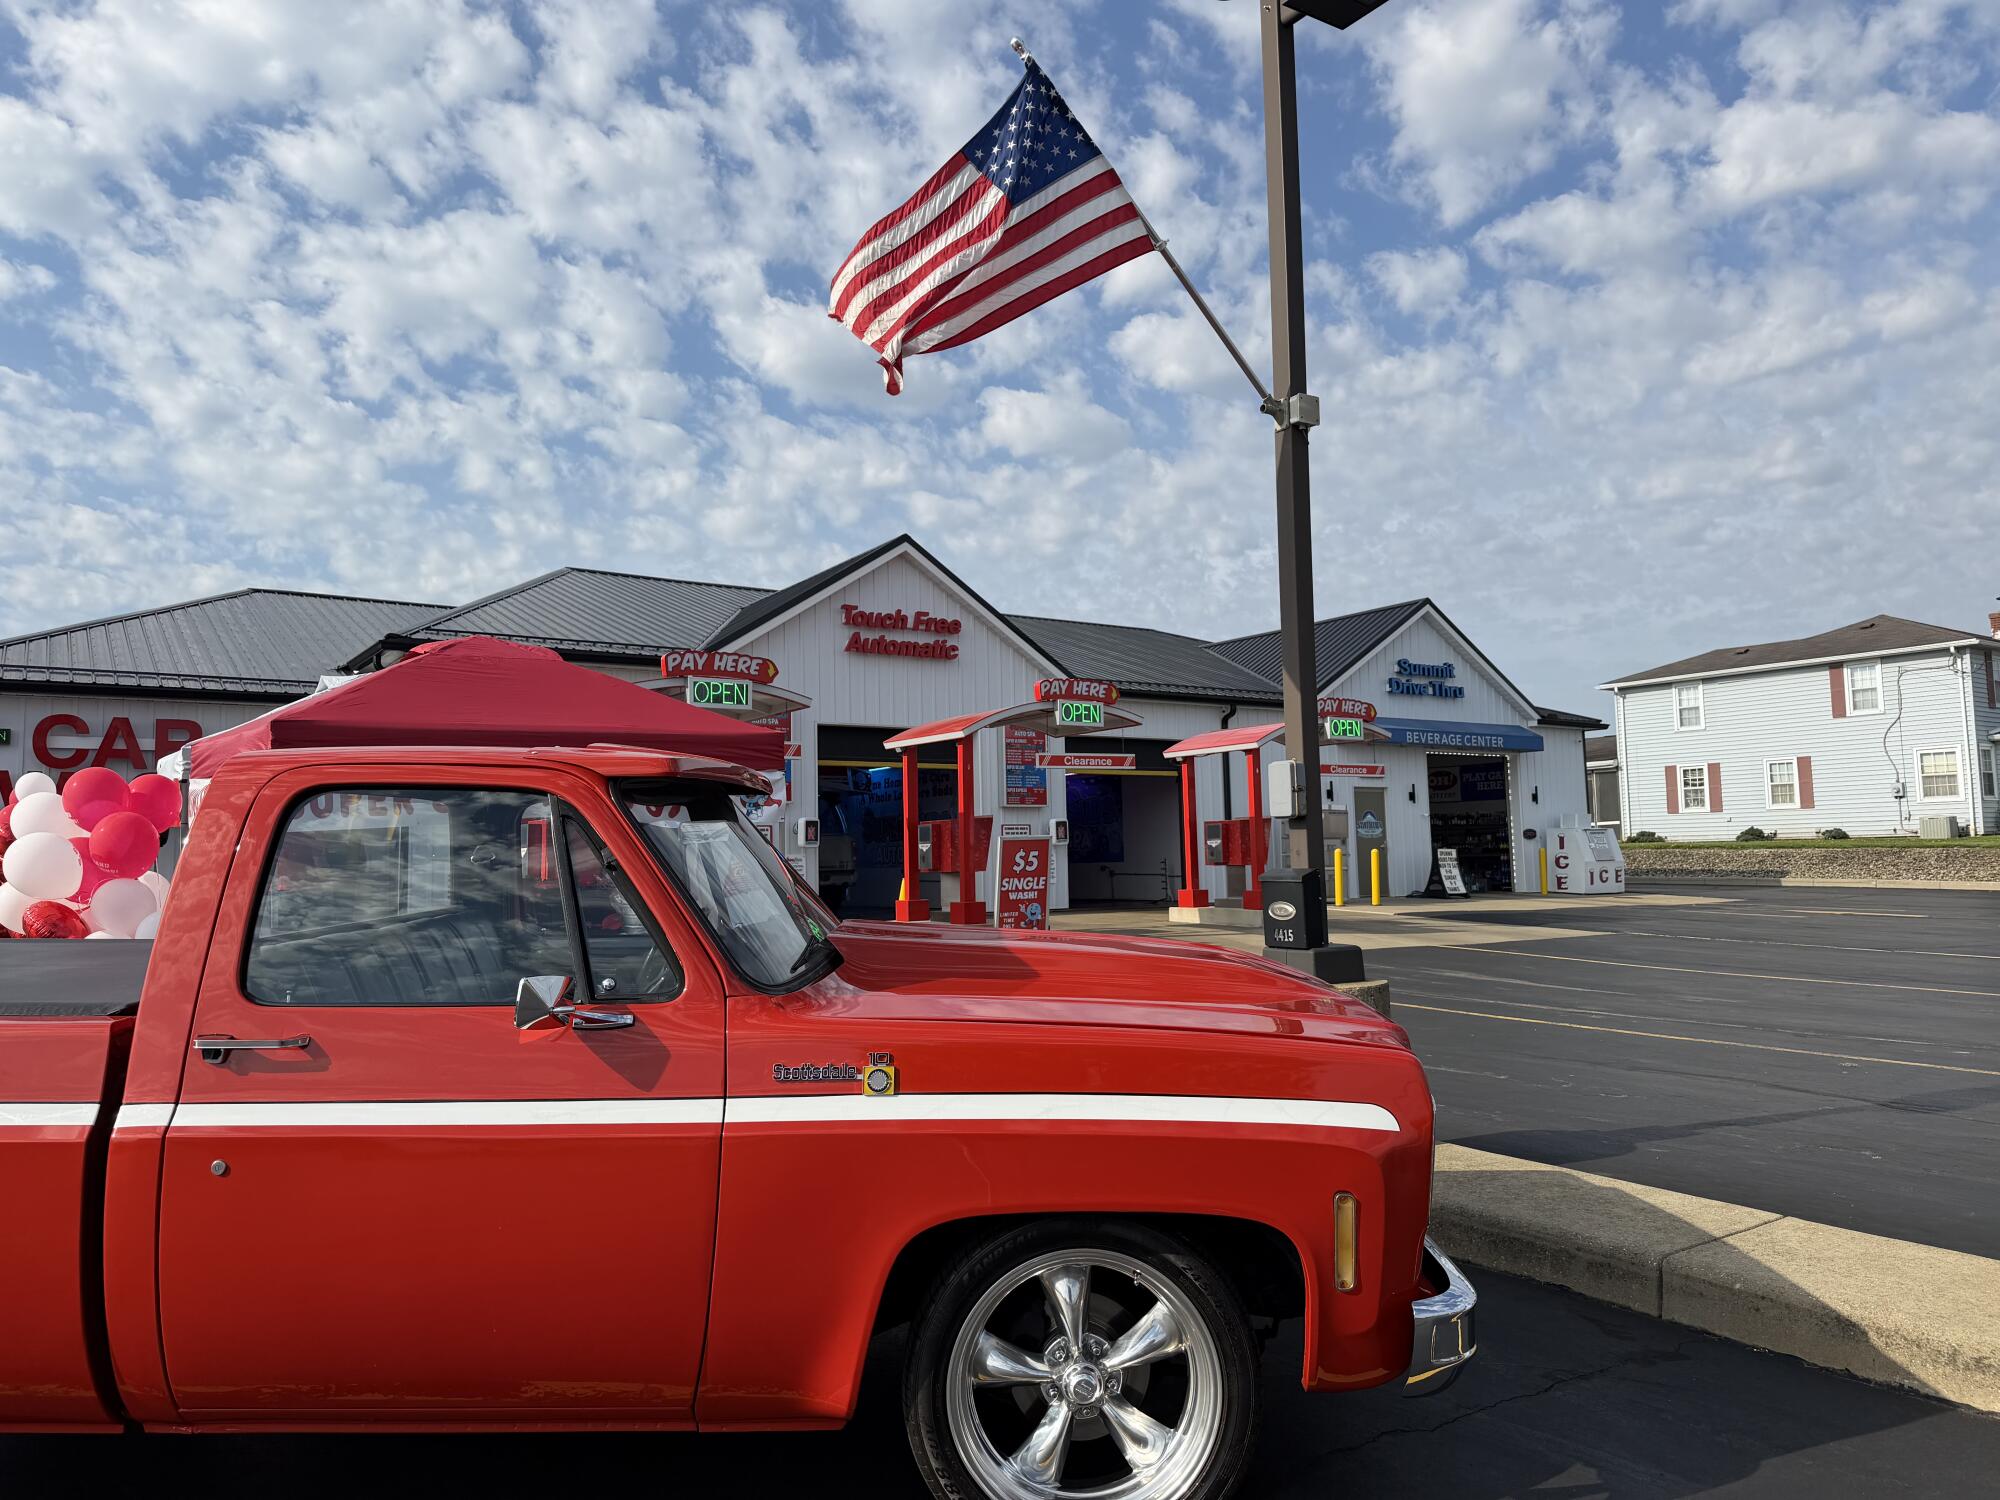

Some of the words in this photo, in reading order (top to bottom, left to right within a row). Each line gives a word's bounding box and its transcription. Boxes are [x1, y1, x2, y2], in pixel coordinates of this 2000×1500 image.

[840, 603, 908, 631] Touch
[911, 611, 962, 635] Free
[843, 631, 960, 660] Automatic
[667, 652, 708, 672] PAY
[714, 654, 763, 675] HERE
[1396, 658, 1456, 679] Summit
[694, 681, 747, 706] OPEN
[1041, 680, 1069, 696] PAY
[1073, 682, 1109, 698] HERE
[1387, 677, 1429, 696] Drive
[1430, 680, 1465, 699] Thru
[1061, 703, 1100, 724] OPEN
[1317, 701, 1338, 713] PAY
[1342, 703, 1369, 716] HERE
[1331, 719, 1361, 738] OPEN
[1406, 731, 1463, 746] BEVERAGE
[1464, 736, 1504, 748] CENTER
[1063, 756, 1113, 767] Clearance
[1330, 765, 1367, 774] Clearance
[1462, 771, 1487, 782] PLAY
[1477, 781, 1504, 791] HERE
[1012, 848, 1039, 874] $5
[1555, 832, 1569, 890] ICE
[1001, 877, 1046, 891] SINGLE
[1588, 867, 1623, 886] ICE
[1008, 891, 1038, 900] WASH!
[1274, 928, 1294, 942] 4415
[867, 1052, 890, 1066] 10
[772, 1063, 857, 1080] Scottsdale
